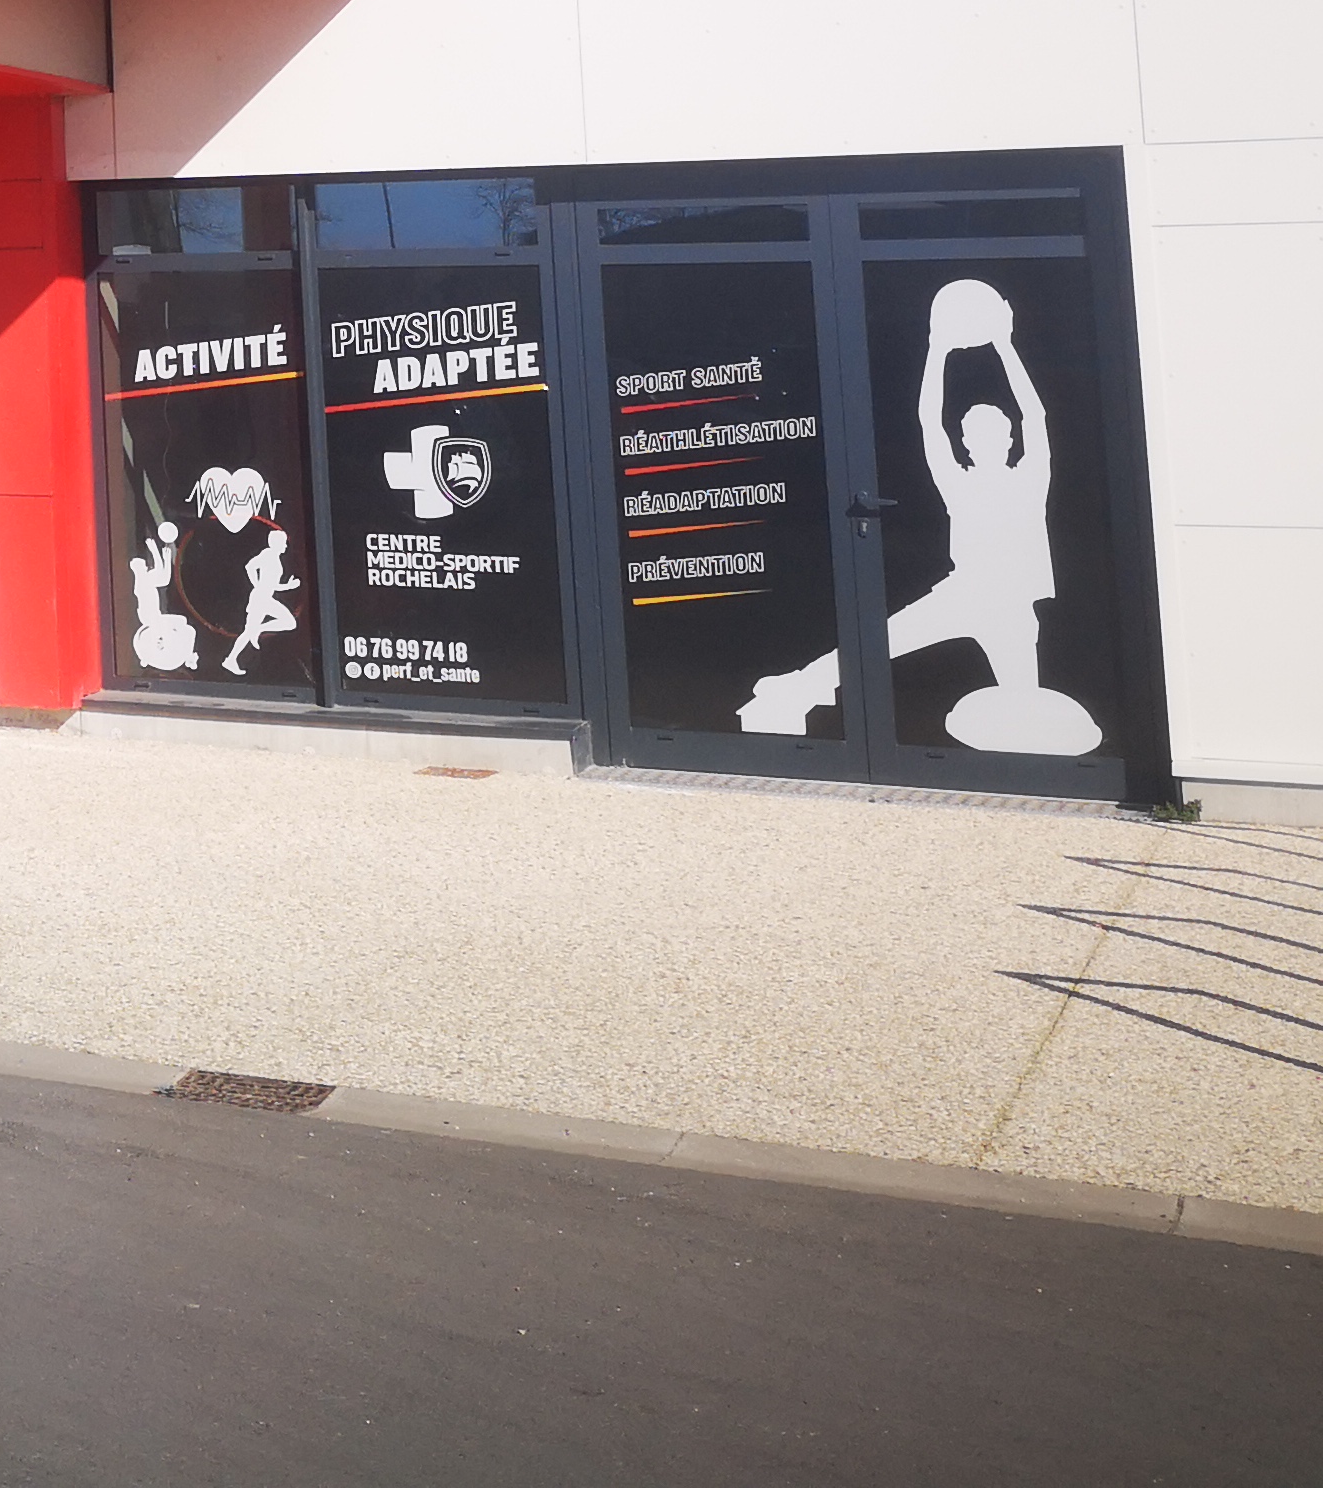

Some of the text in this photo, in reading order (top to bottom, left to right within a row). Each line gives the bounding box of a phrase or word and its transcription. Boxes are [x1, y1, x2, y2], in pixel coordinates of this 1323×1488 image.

[331, 301, 517, 357] PHYSIQUE
[134, 324, 287, 382] ACTIVITÉ
[373, 337, 540, 393] ADAPTÉE
[616, 356, 763, 396] SPORT SANTÉ
[620, 416, 817, 456] RÉATHLÉTISATION
[624, 482, 786, 517] RÉADAPTATION
[366, 534, 442, 552] CENTRE
[366, 551, 520, 573] MEDICO-SPORTIF
[628, 552, 765, 582] PRÉVENTION
[367, 569, 476, 589] ROCHELAIS
[344, 636, 468, 663] 06 76 99 74 18
[383, 662, 480, 683] perf_et_sante
